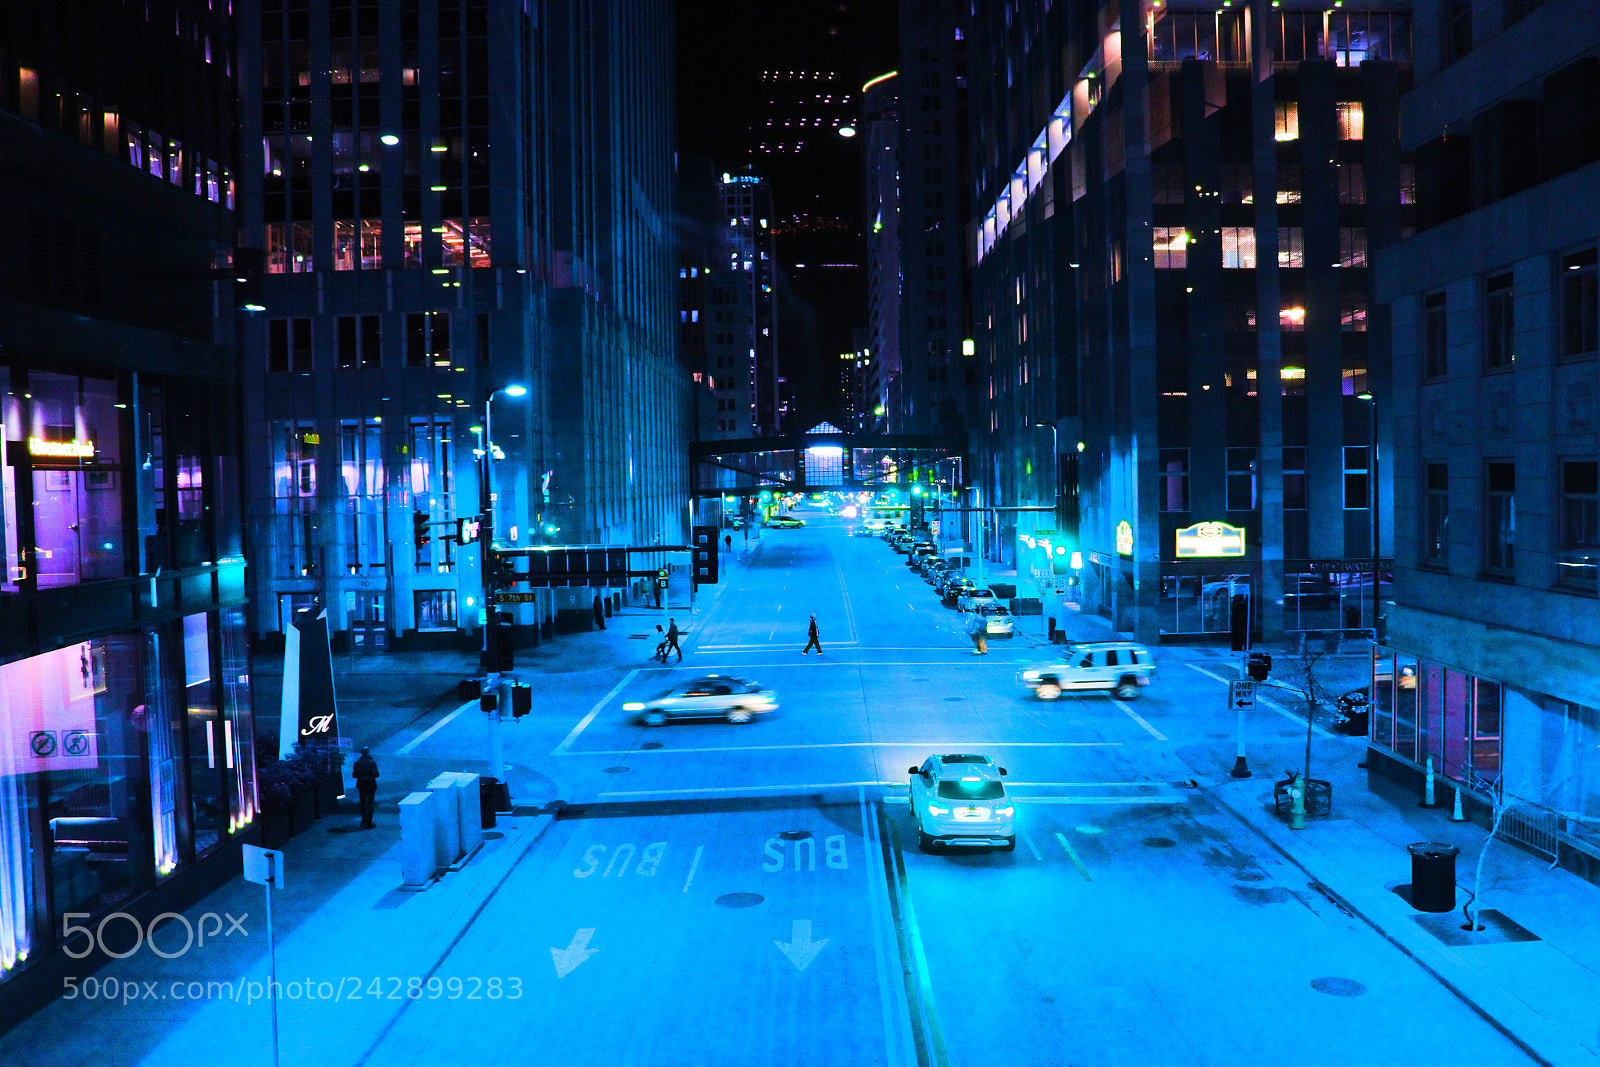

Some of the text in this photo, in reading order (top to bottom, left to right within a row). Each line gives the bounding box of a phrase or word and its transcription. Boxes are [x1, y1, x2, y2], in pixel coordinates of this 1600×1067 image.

[499, 594, 533, 602] S 7th St
[1236, 682, 1253, 690] ONE
[1235, 690, 1253, 698] WAY
[762, 834, 849, 873] BUS
[573, 841, 668, 879] BUS
